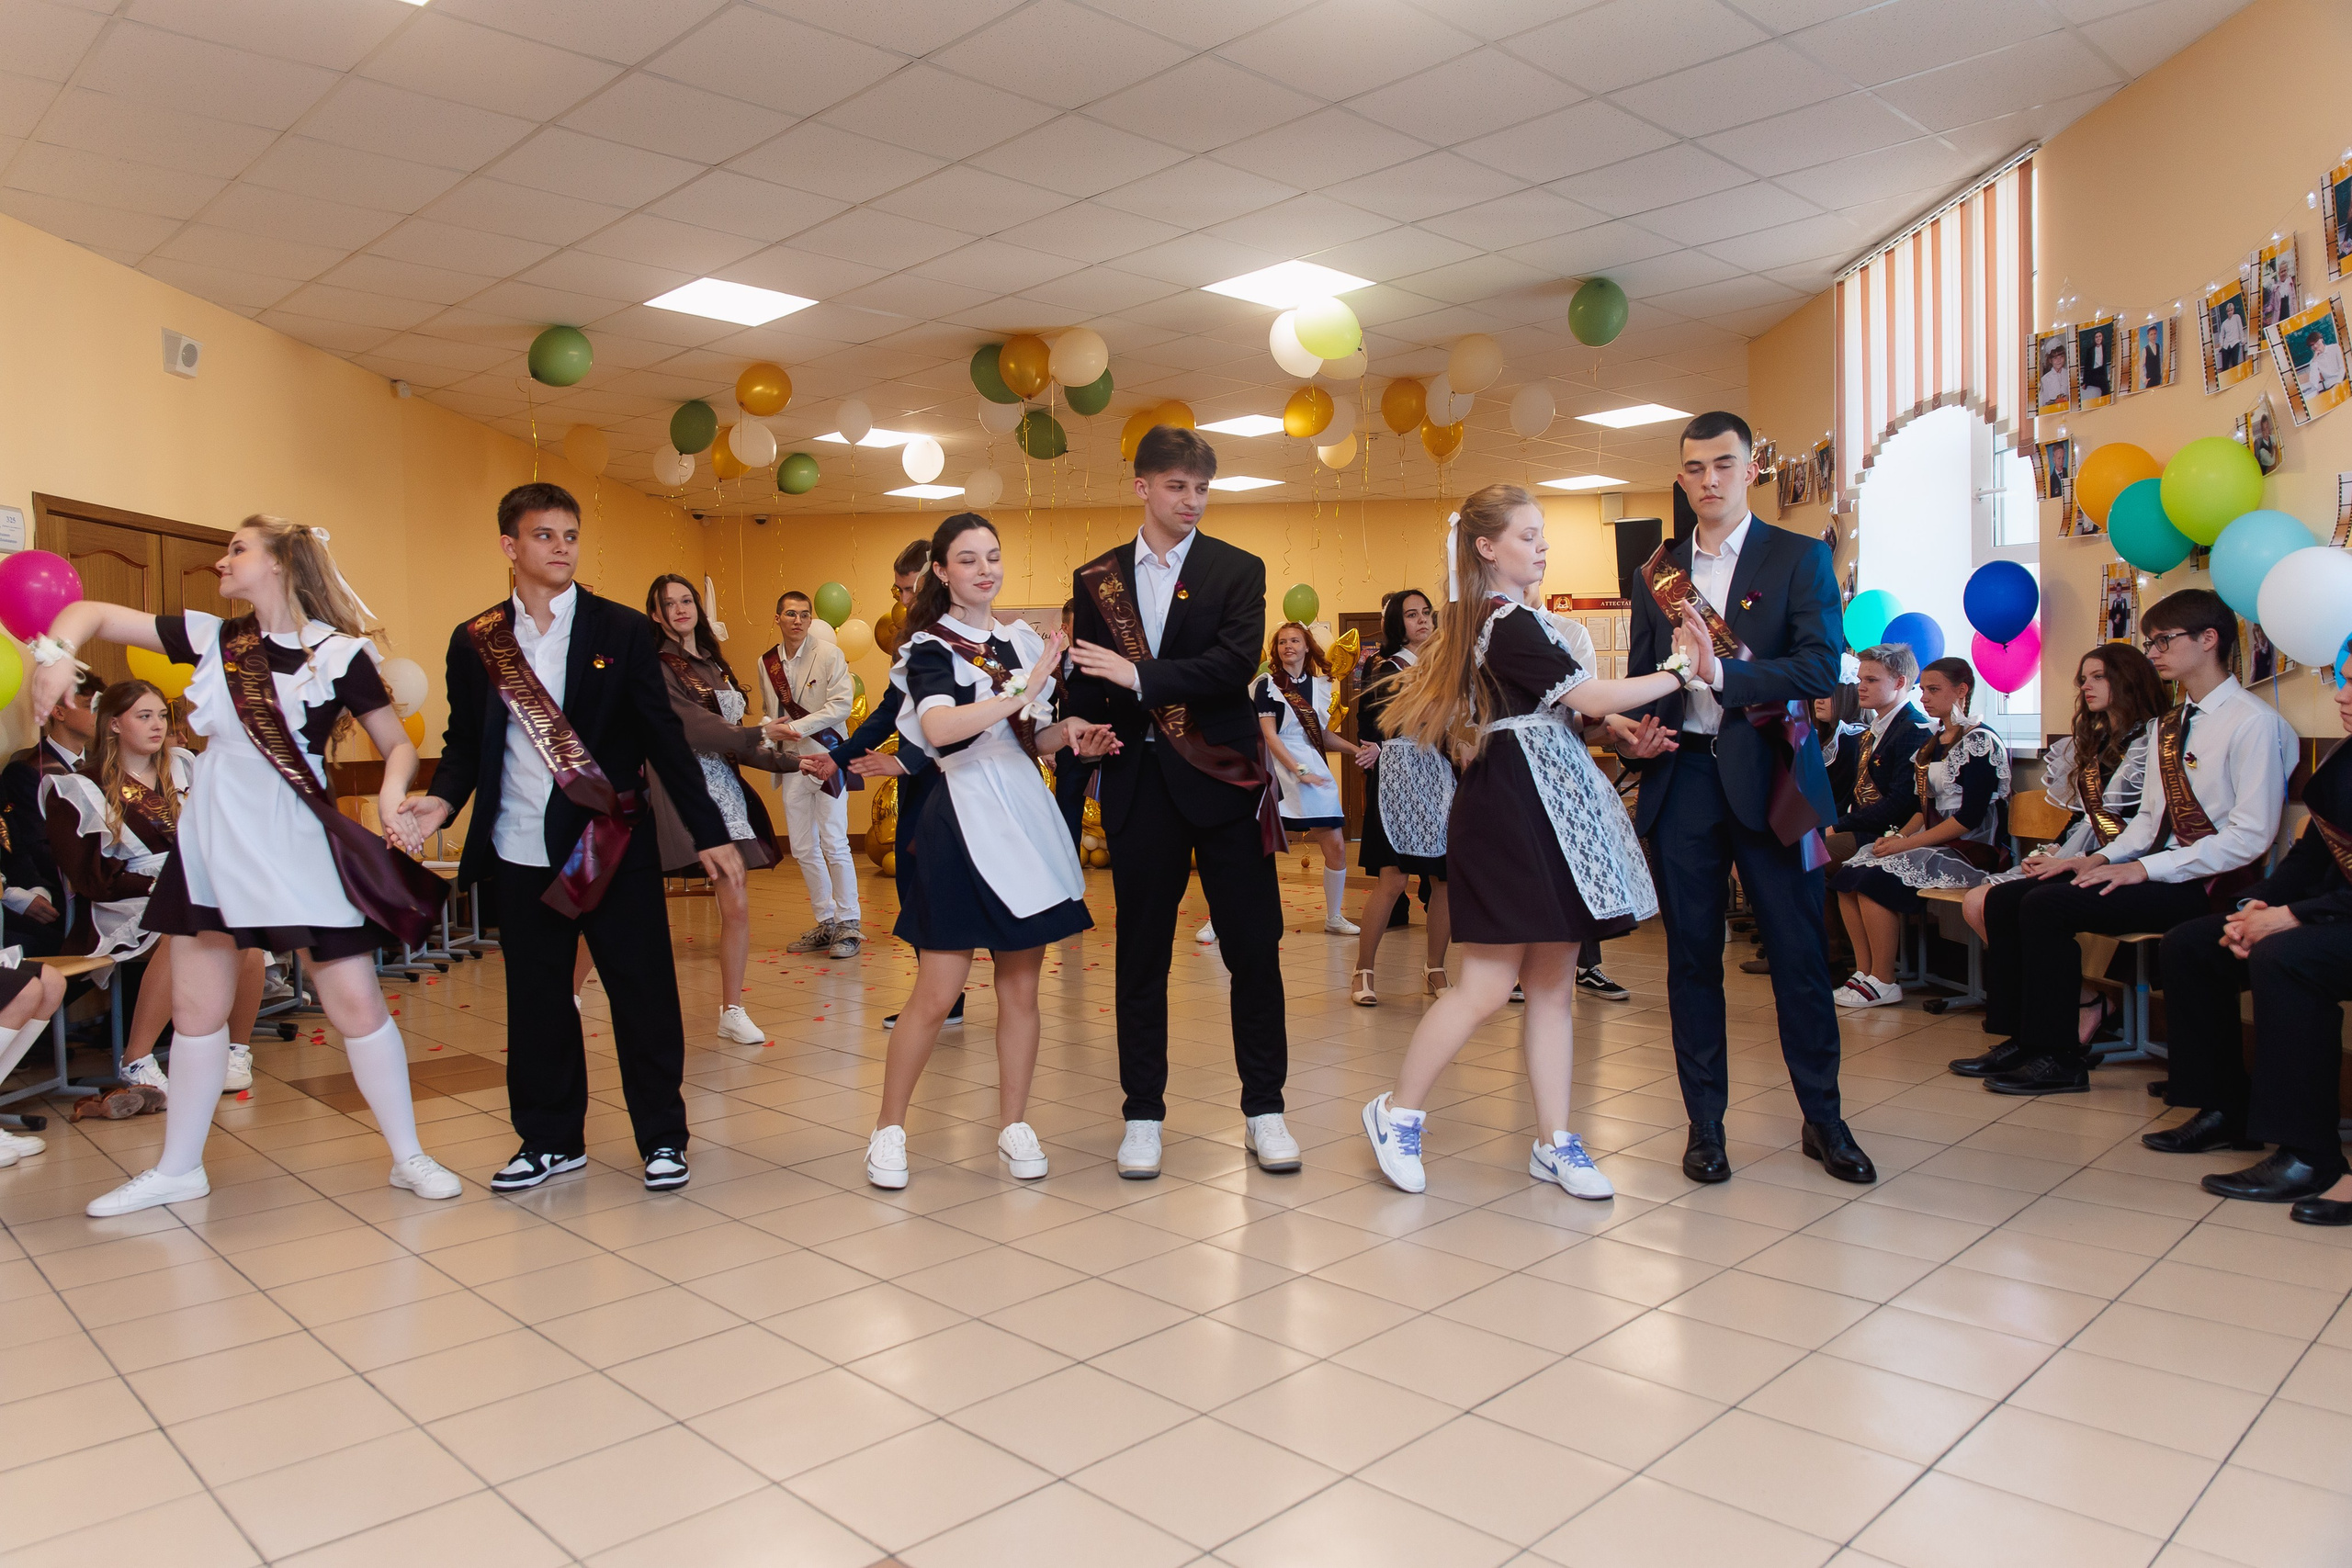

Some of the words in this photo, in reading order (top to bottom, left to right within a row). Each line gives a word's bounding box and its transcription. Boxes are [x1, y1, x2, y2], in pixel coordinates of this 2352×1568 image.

[238, 654, 295, 765] Выпускница
[488, 630, 556, 737] Выпускник
[542, 730, 592, 772] 2024
[2162, 728, 2184, 807] Выпускник
[2175, 802, 2212, 837] 2024
